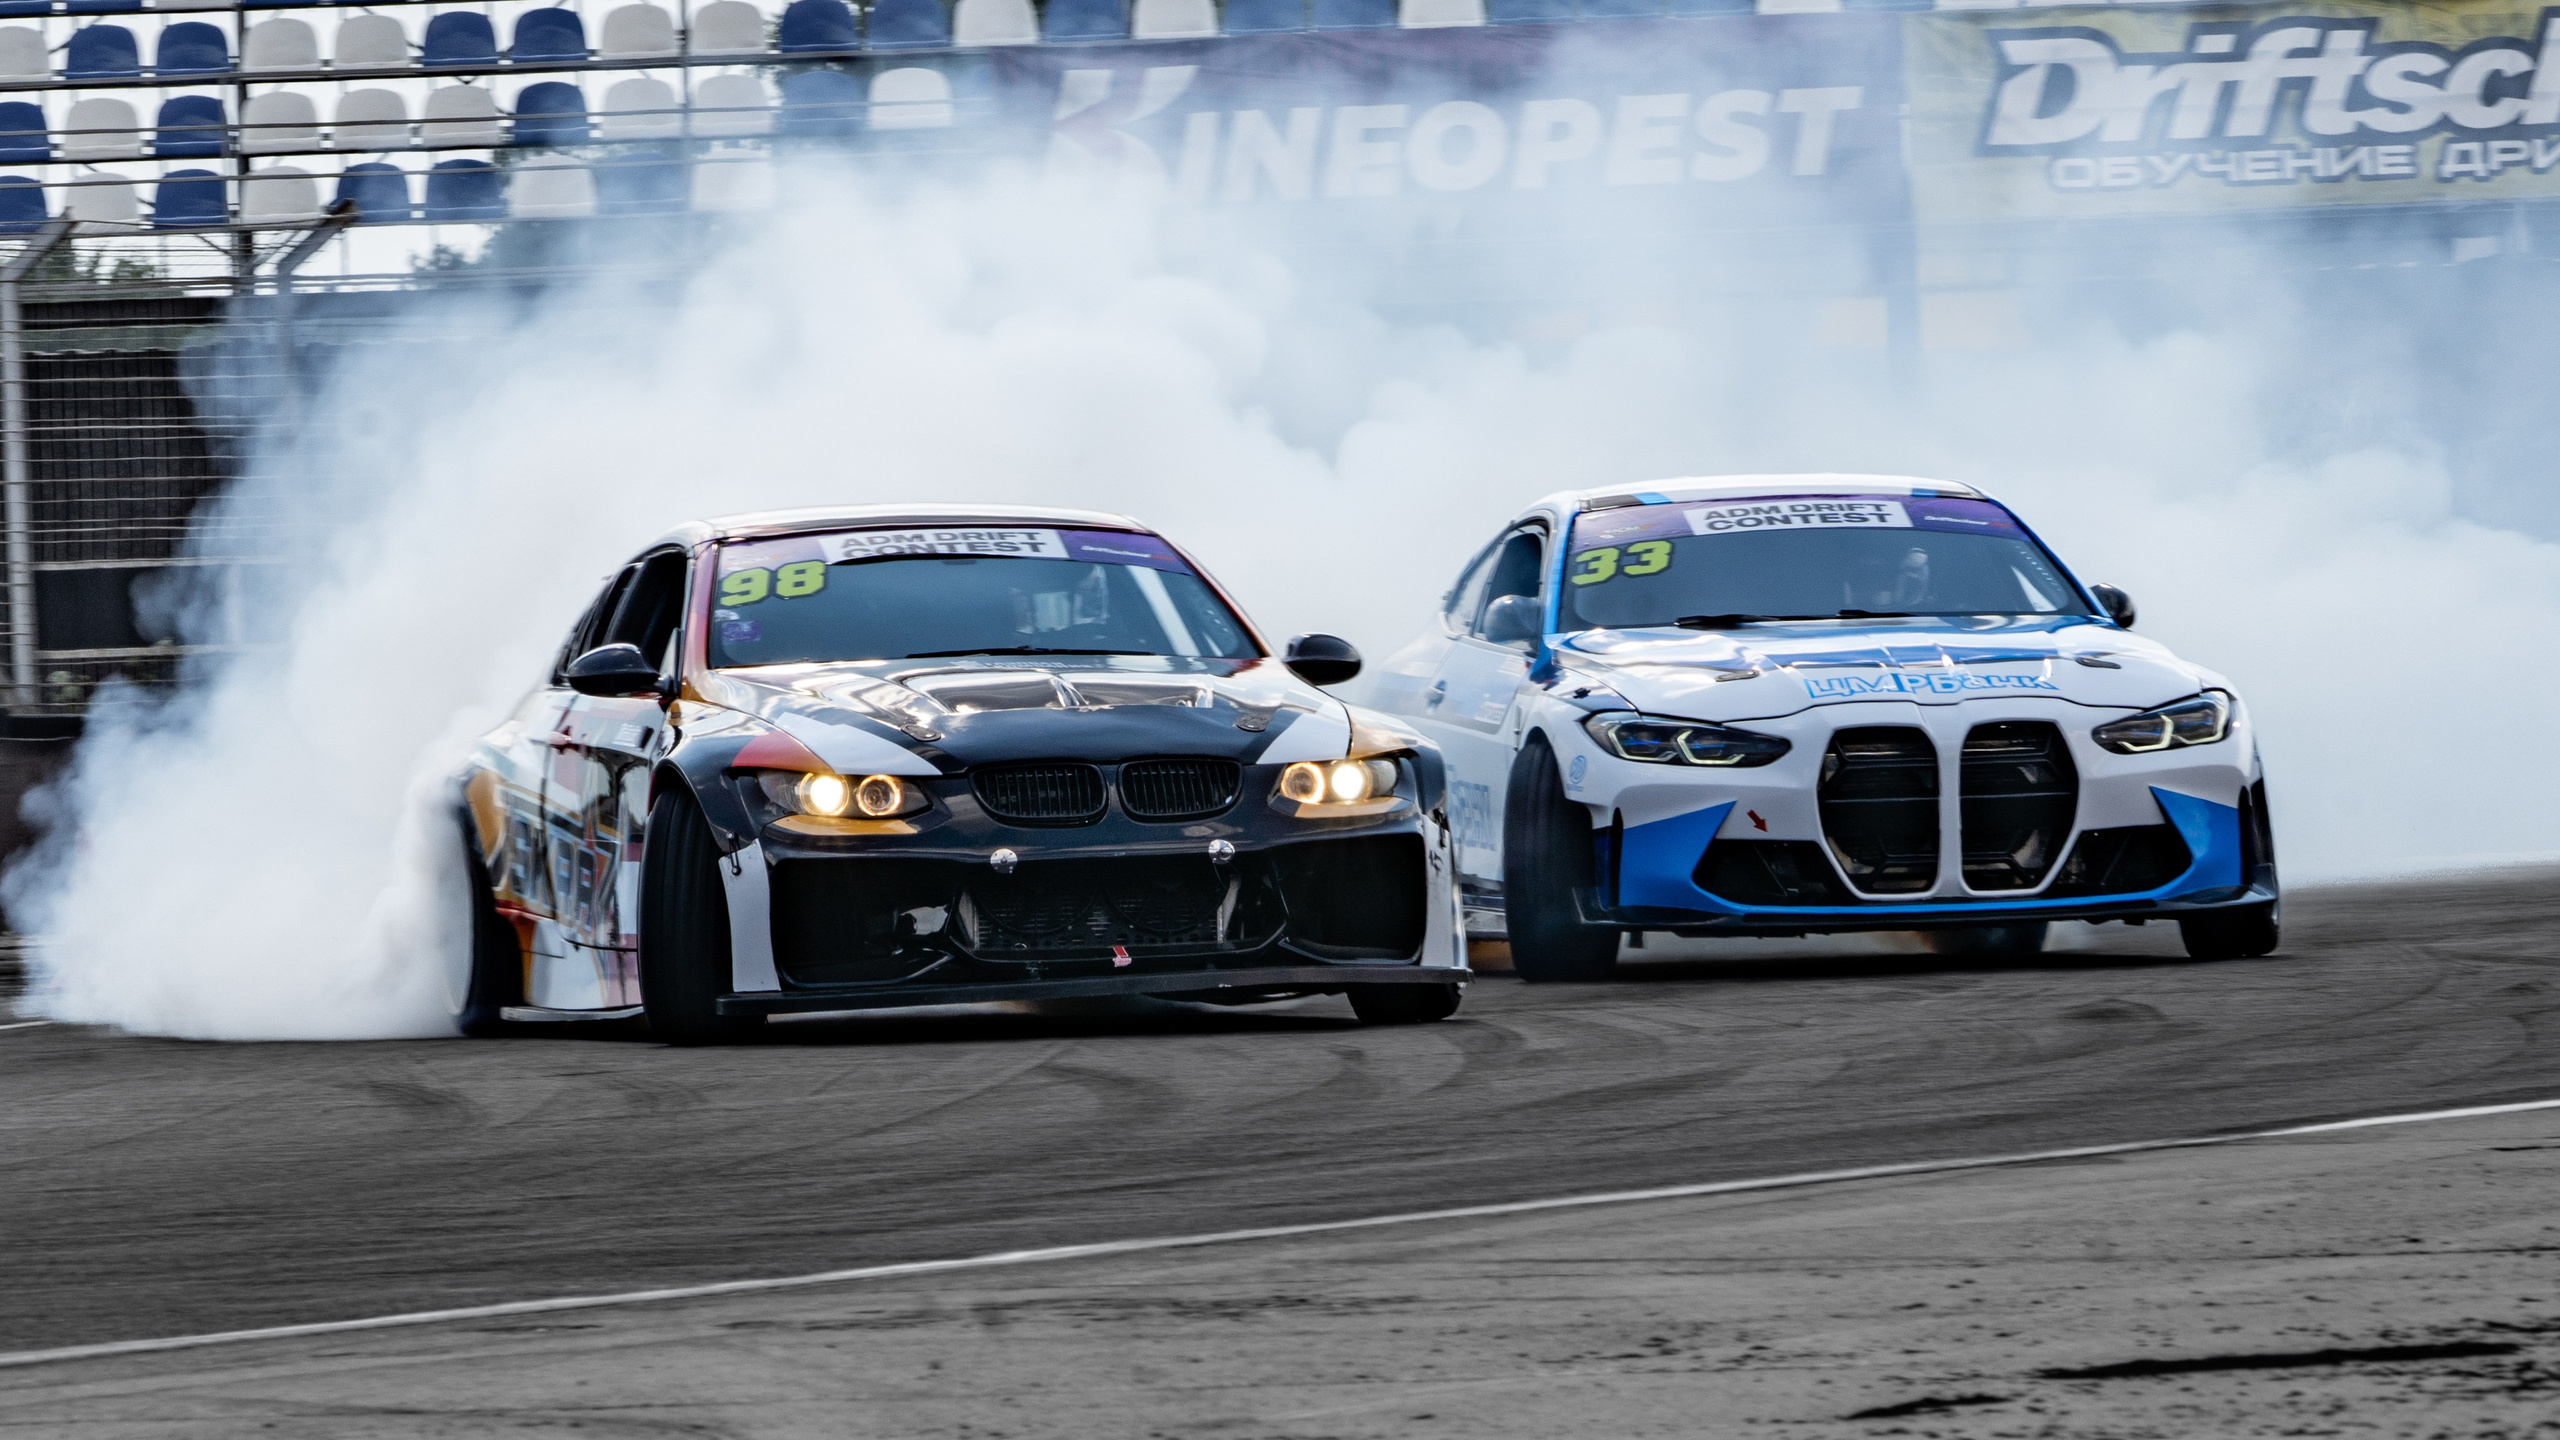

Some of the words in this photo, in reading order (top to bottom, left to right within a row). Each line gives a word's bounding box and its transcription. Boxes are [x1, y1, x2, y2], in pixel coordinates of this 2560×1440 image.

[2052, 144, 2416, 189] ОБУЧЕНИЕ
[1703, 505, 1780, 521] ADM
[1787, 502, 1887, 514] DRIFT
[1706, 512, 1893, 531] CONTEST
[840, 532, 927, 549] ADM
[933, 531, 1043, 543] DRIFT
[841, 541, 1048, 559] CONTEST
[1570, 540, 1673, 586] 33
[719, 559, 827, 607] 98
